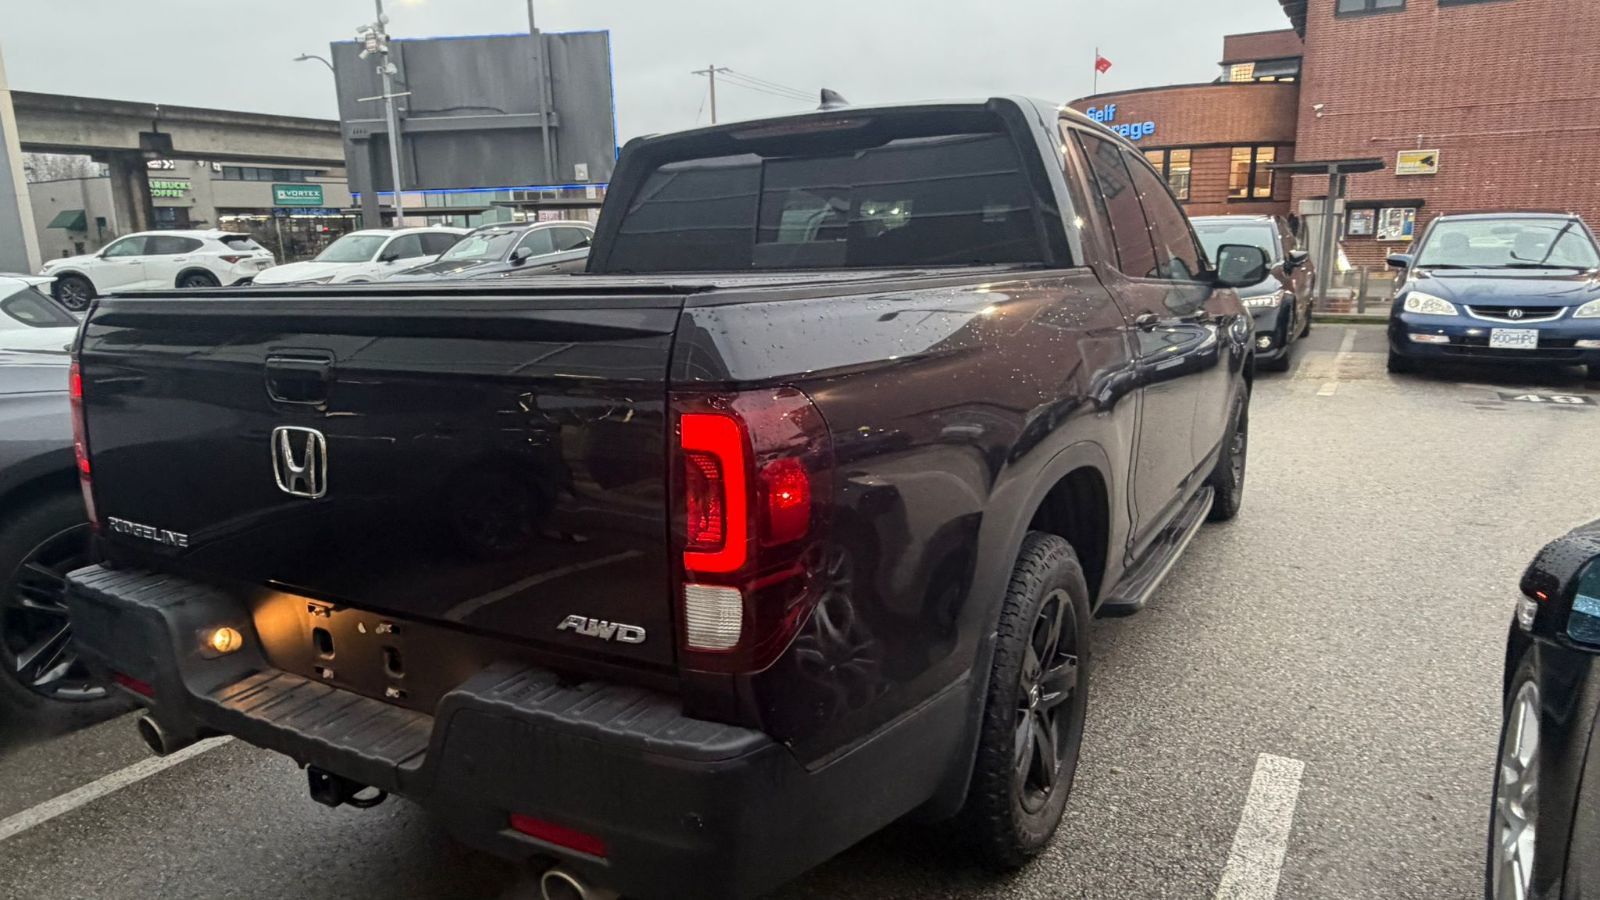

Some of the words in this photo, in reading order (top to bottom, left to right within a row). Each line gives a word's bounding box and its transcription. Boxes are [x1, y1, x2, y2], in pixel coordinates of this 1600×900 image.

[1087, 104, 1116, 121] Self
[108, 516, 188, 547] RIDGELINE
[556, 614, 646, 644] AWD
